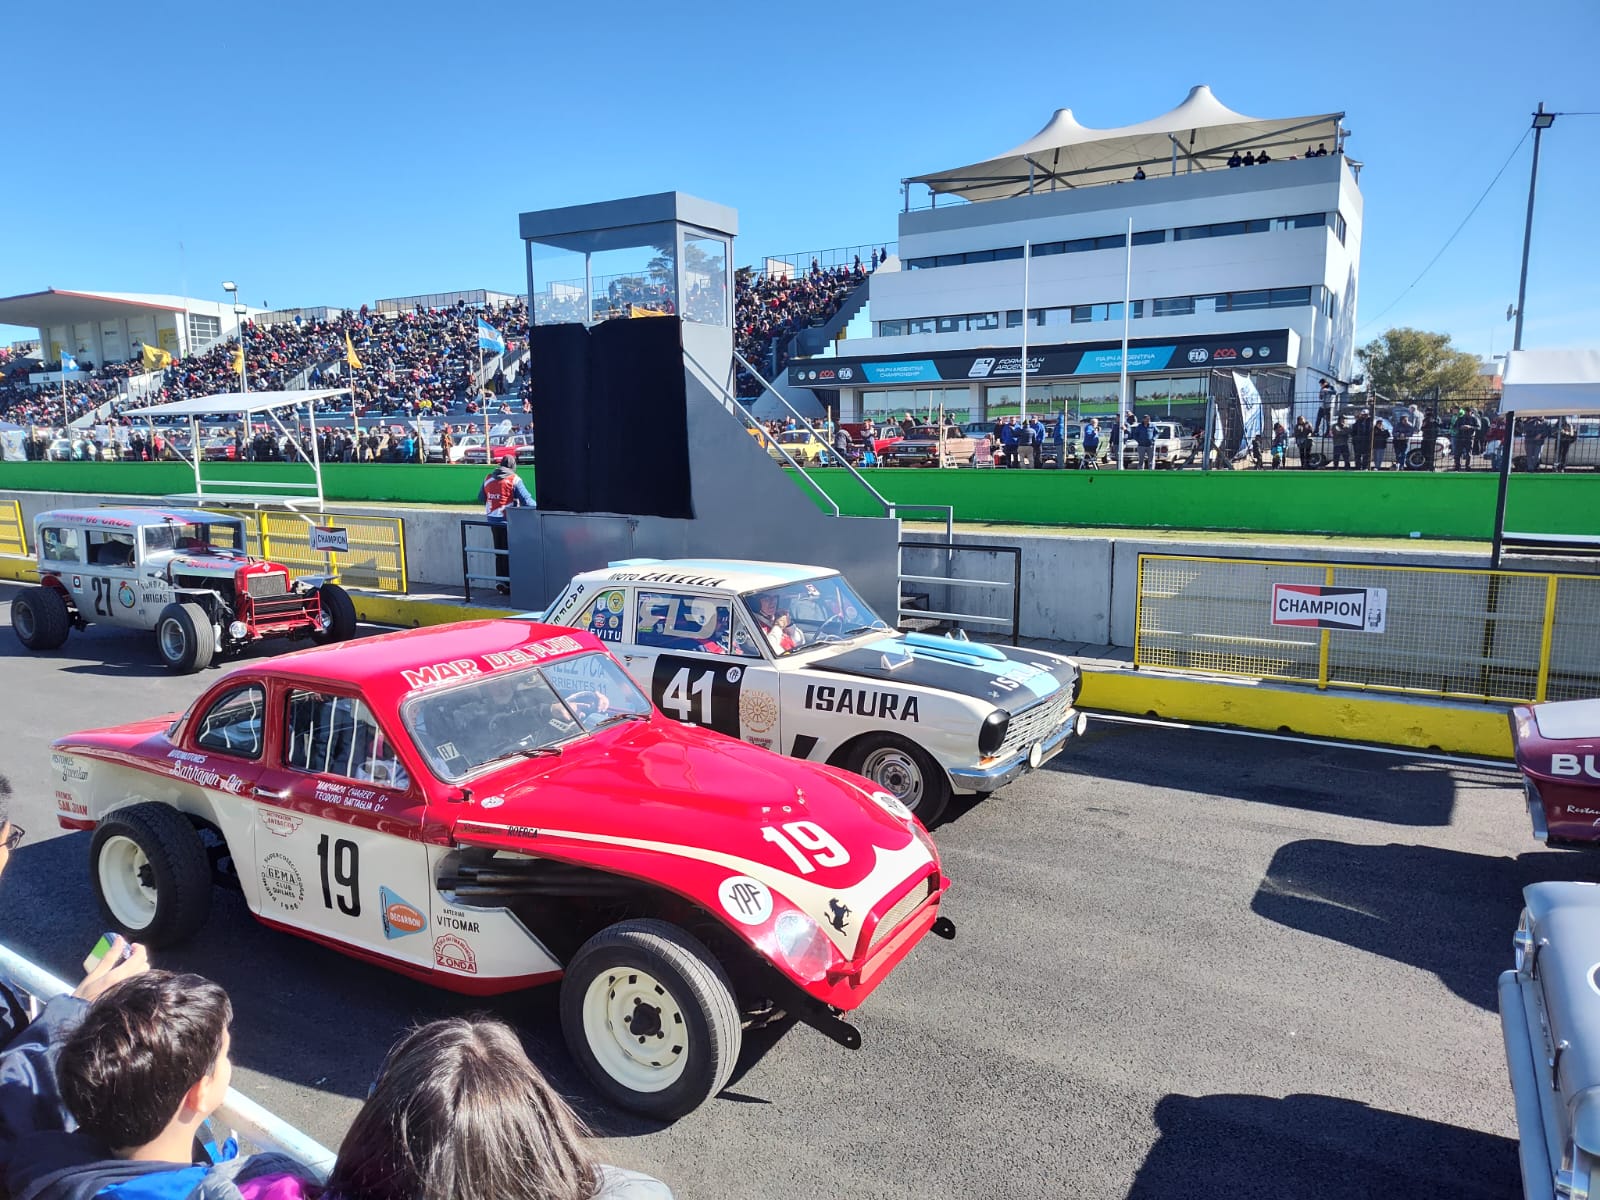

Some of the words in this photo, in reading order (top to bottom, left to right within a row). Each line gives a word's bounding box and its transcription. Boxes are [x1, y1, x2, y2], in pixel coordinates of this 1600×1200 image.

[1100, 359, 1151, 367] CHAMPONSHIP
[1117, 353, 1155, 361] AGENTINA
[1191, 351, 1207, 361] FIA
[839, 369, 852, 380] FIA
[317, 534, 347, 545] CHAMPION
[91, 577, 115, 617] 27
[1279, 598, 1362, 617] CHAMPION
[400, 659, 482, 689] MAR
[662, 667, 716, 725] 41
[805, 684, 920, 723] ISAURA
[760, 821, 851, 875] 19
[268, 867, 297, 884] GEMA
[317, 833, 361, 918] 19
[276, 881, 292, 891] CLUB
[729, 883, 765, 916] YPF
[437, 915, 480, 934] VITOMAR
[437, 955, 476, 972] ZONDA
